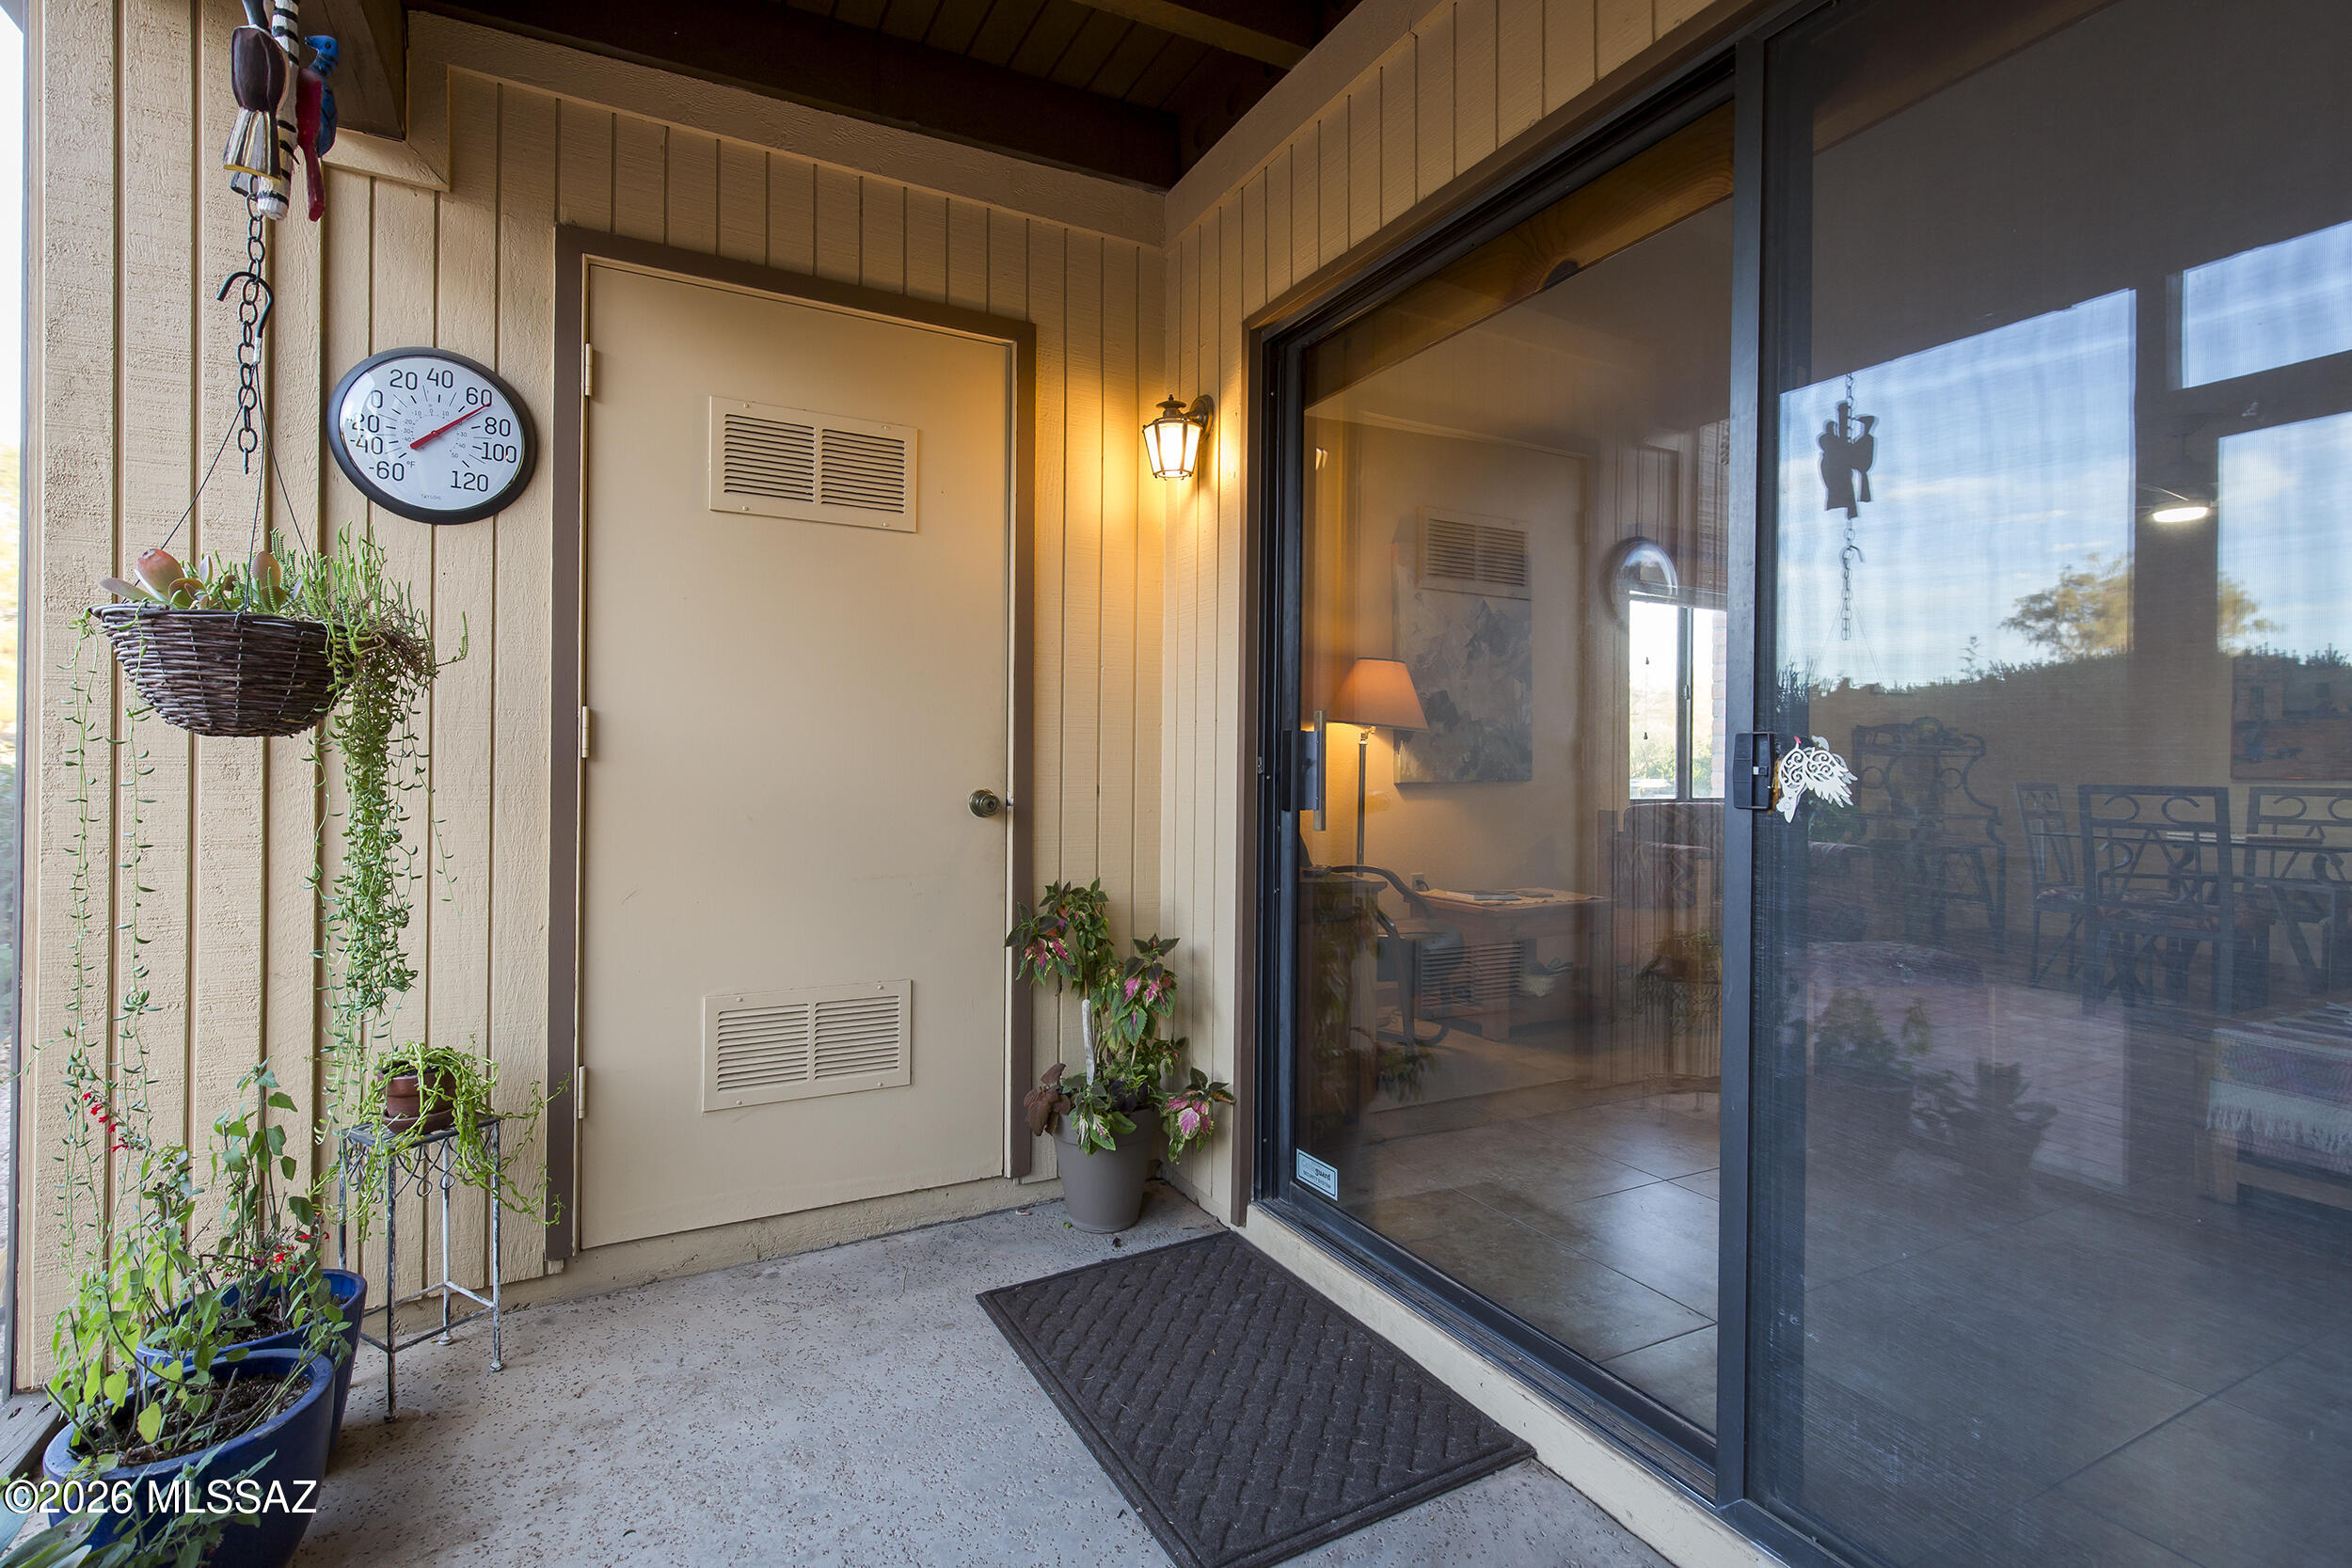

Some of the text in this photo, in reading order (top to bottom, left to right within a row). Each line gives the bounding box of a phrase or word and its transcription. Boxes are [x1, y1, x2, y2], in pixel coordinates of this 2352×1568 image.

[389, 369, 418, 390] 20
[427, 368, 453, 388] 40
[371, 389, 383, 408] 0
[466, 387, 492, 407] 60
[485, 417, 511, 437] 80
[350, 434, 383, 454] -40
[481, 442, 517, 464] 100
[369, 461, 405, 481] -60
[450, 470, 488, 492] 120
